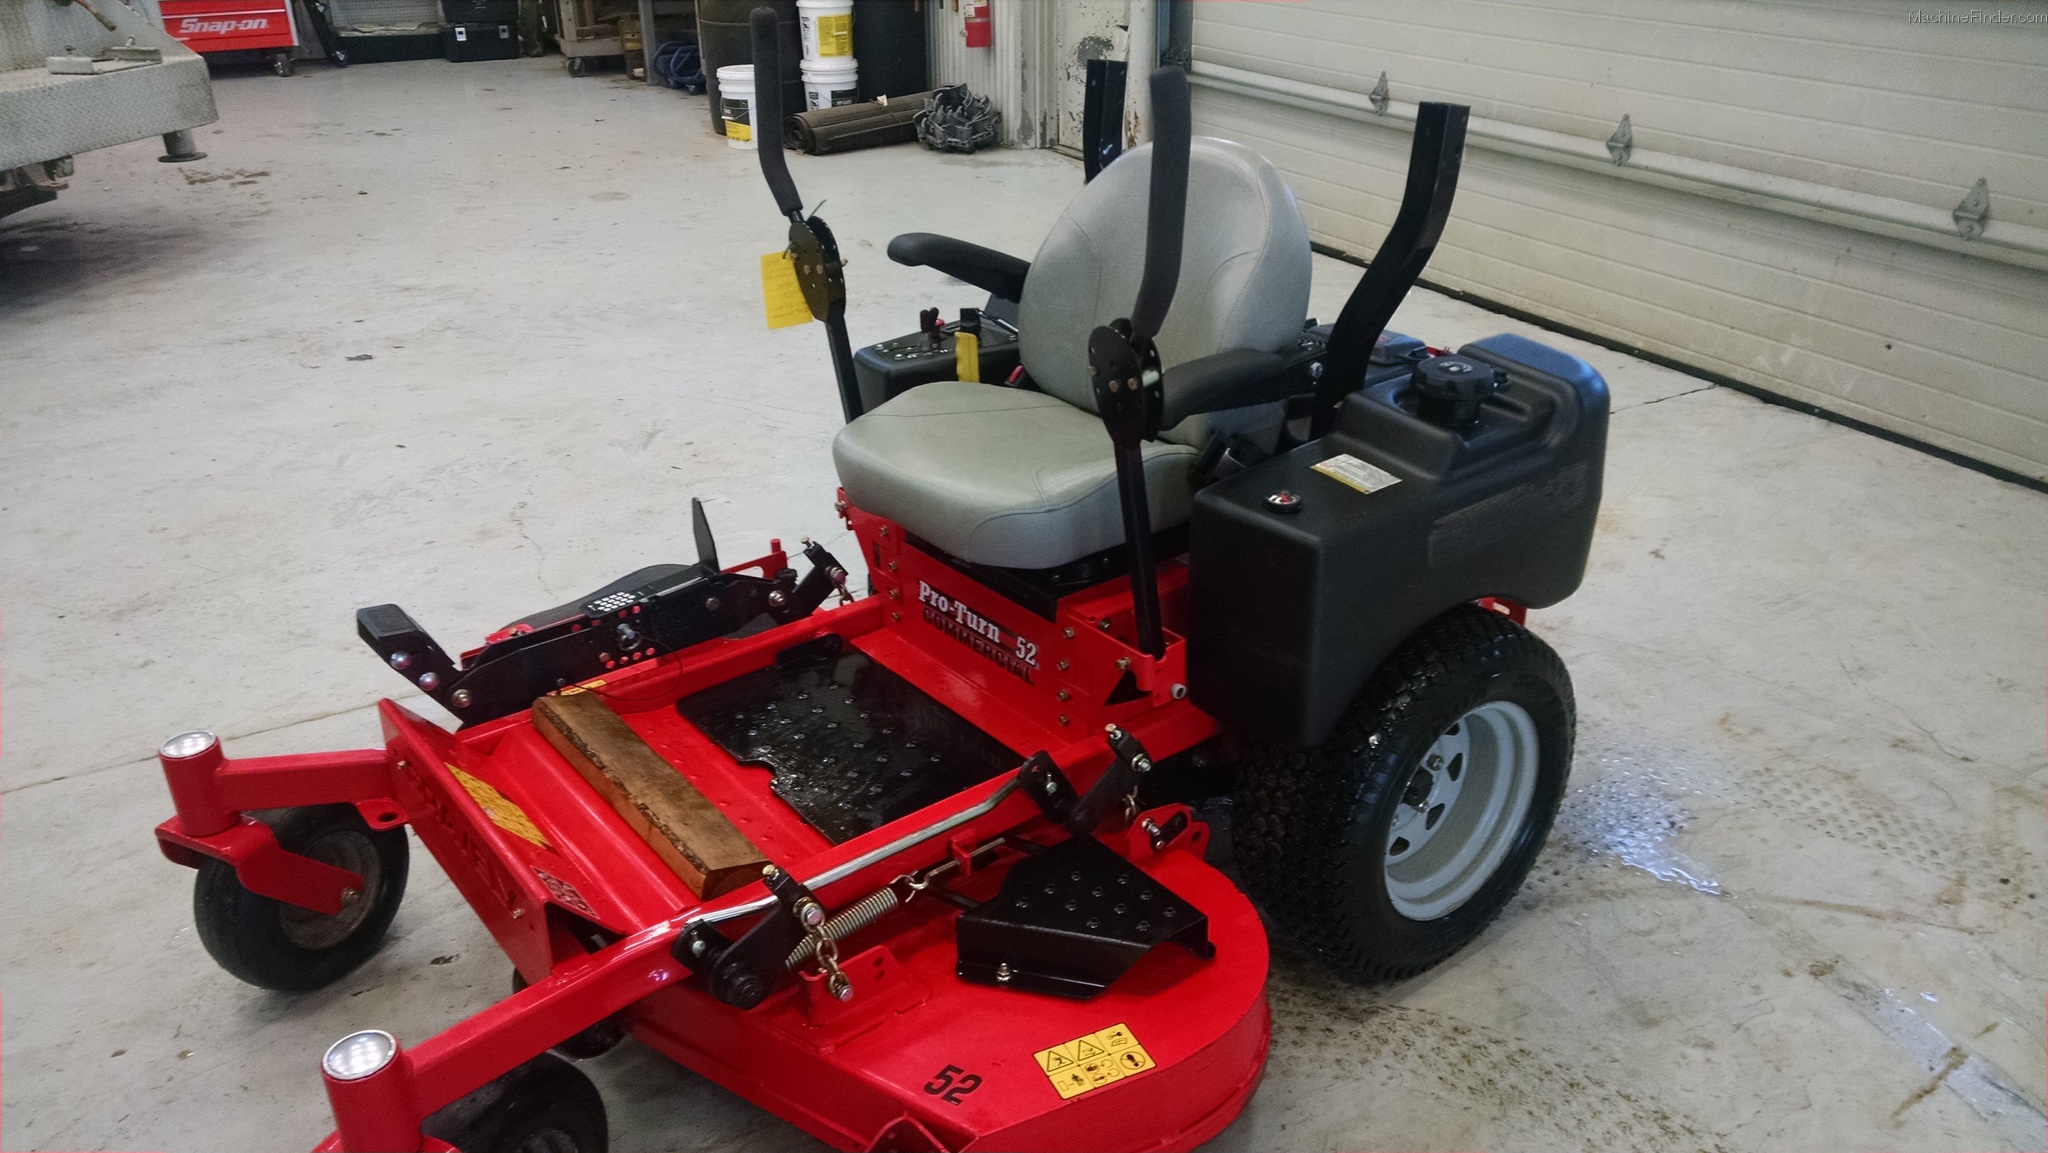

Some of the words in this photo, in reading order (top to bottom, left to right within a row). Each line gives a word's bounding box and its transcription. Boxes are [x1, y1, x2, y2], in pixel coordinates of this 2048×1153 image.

[178, 18, 268, 35] Snap-on
[918, 579, 1001, 644] Pro-Turn
[1015, 636, 1038, 668] 52
[923, 608, 1034, 686] COMMERCIAL
[923, 1063, 983, 1106] 52
